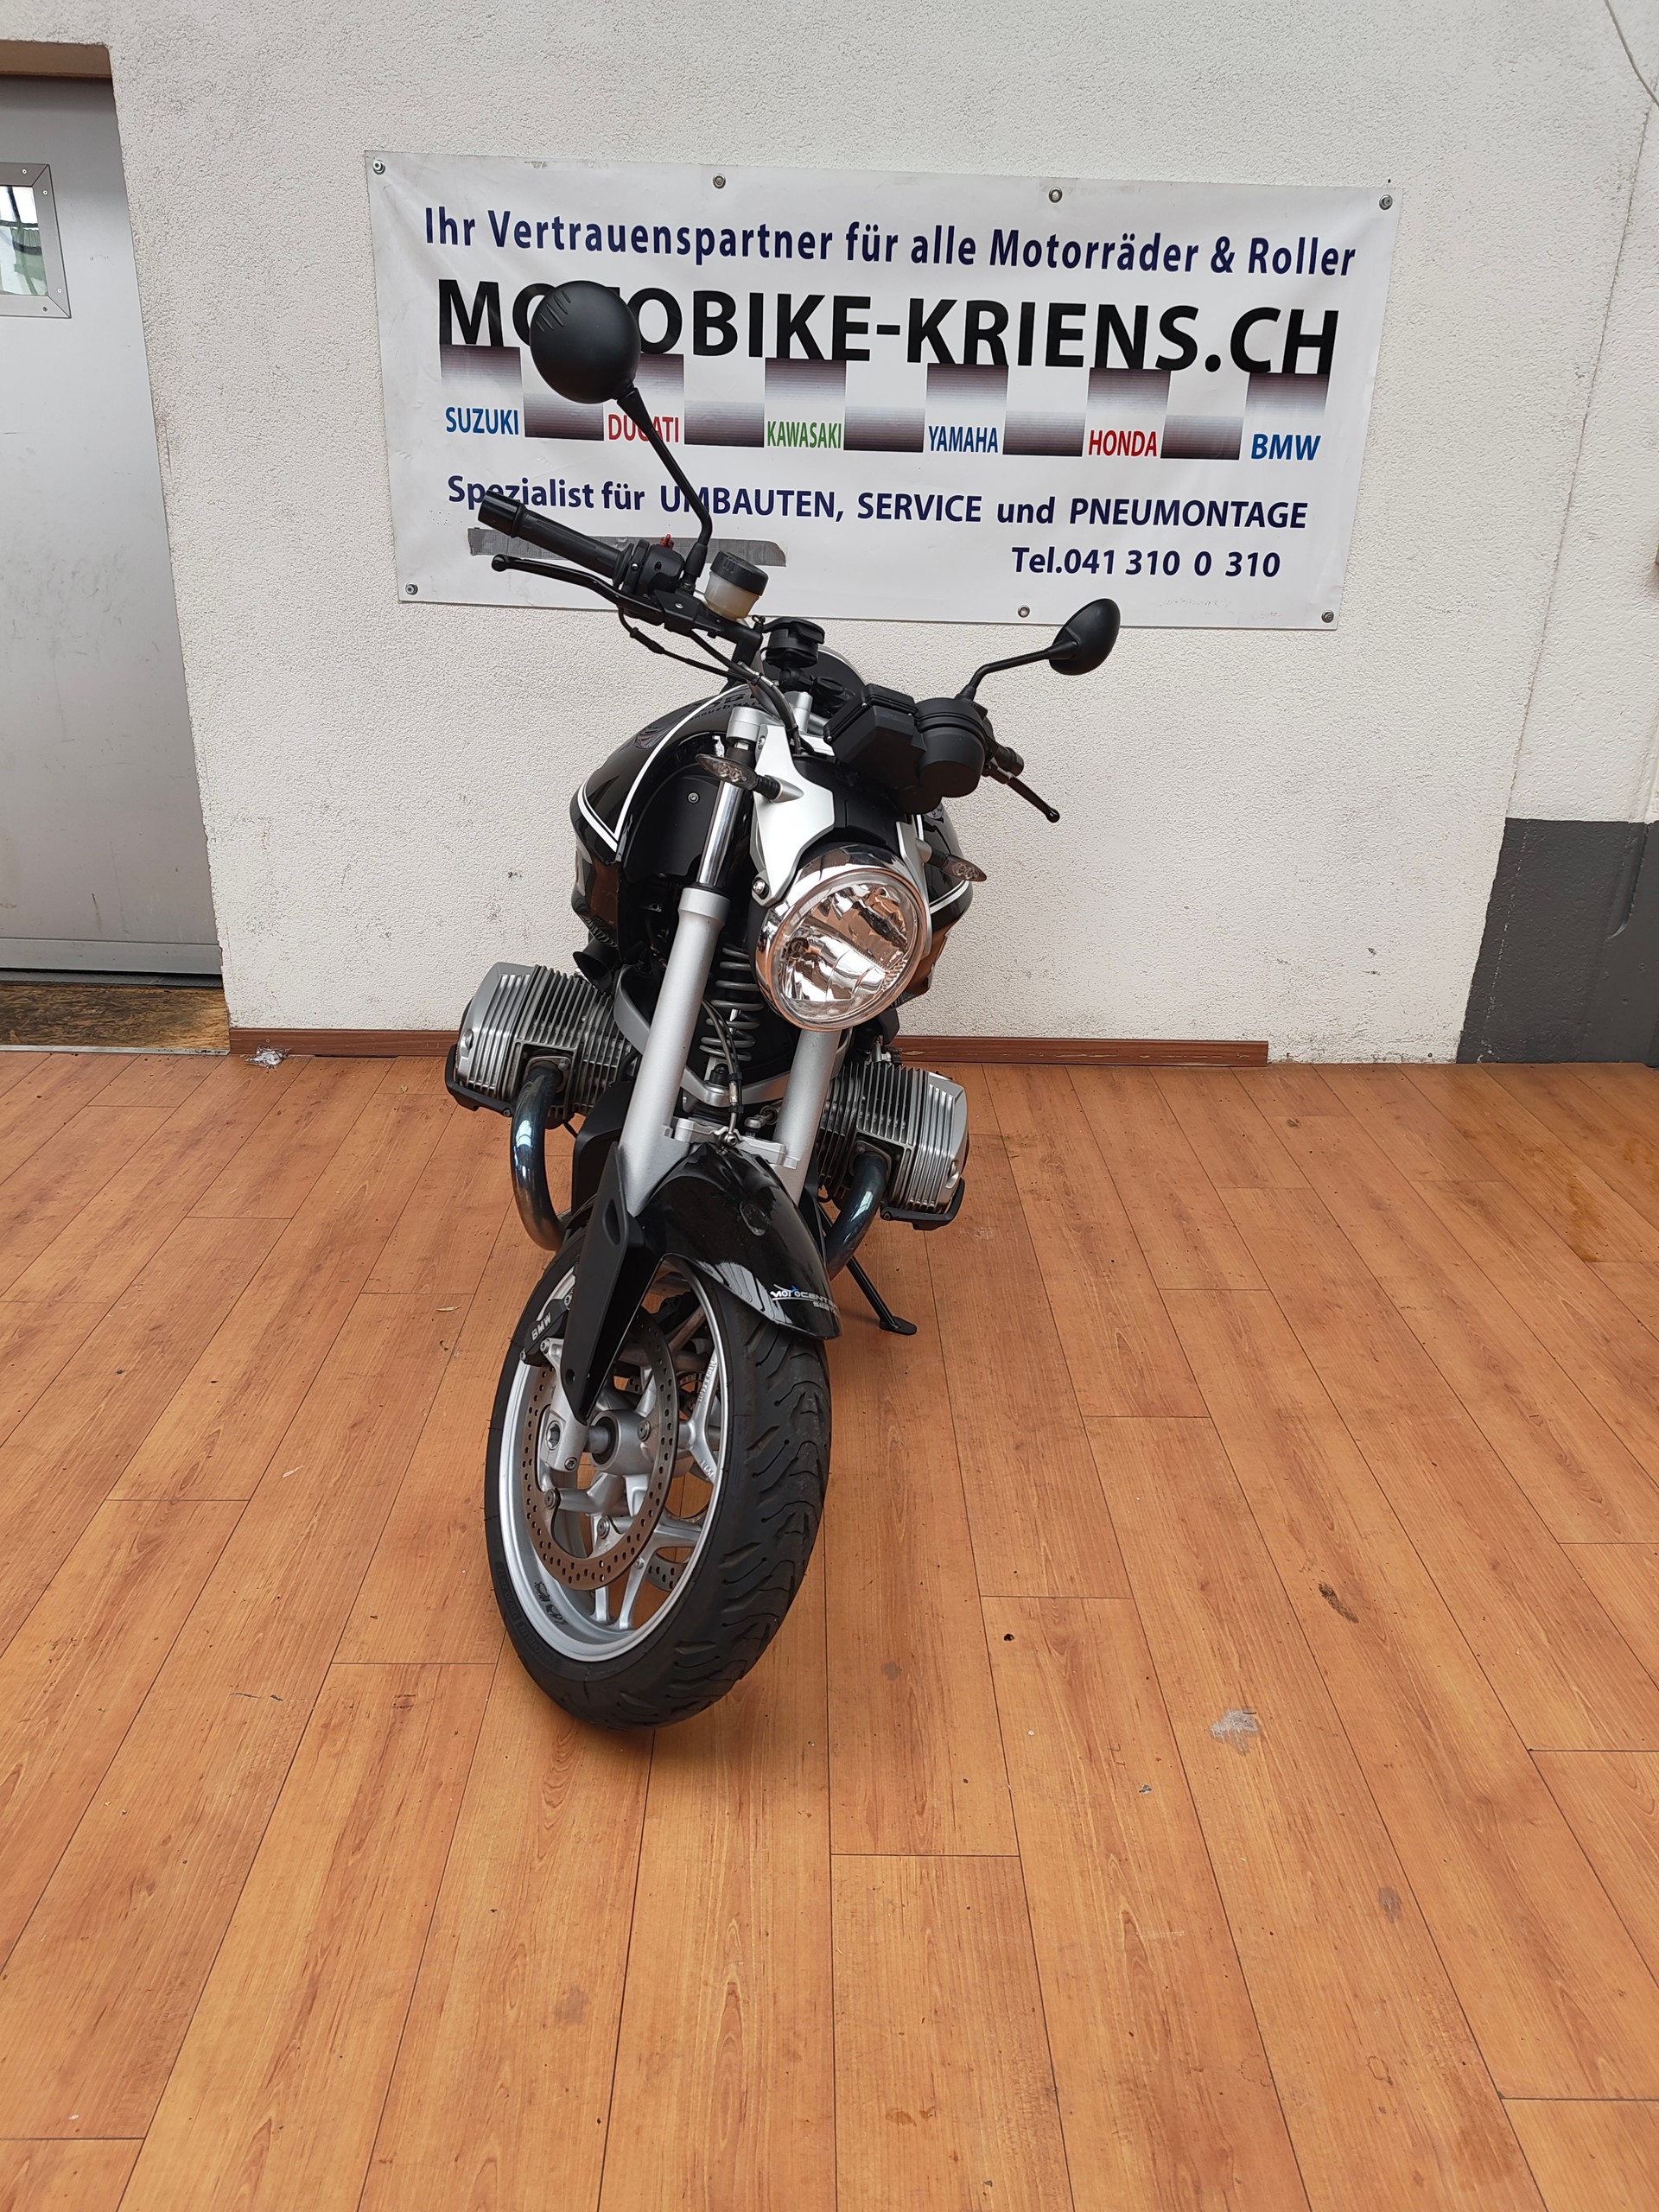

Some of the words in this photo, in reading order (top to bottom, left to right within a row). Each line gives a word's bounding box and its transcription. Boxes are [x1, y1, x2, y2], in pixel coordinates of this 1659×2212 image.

[426, 207, 475, 245] Ihr
[488, 210, 832, 265] Vertrauenspartner
[846, 222, 898, 262] für
[912, 226, 976, 265] alle
[990, 229, 1198, 271] Motorräder
[1211, 237, 1235, 273] &
[1249, 237, 1356, 276] Roller
[438, 279, 1338, 374] MOBIKE-KRIENS.CH
[446, 407, 518, 435] SUZUKI
[766, 421, 842, 448] KAWASAKI
[929, 426, 998, 452] YAMAHA
[1089, 430, 1157, 456] HONDA
[1251, 434, 1320, 460] BMW
[601, 481, 645, 510] für
[858, 493, 982, 522] SERVICE
[998, 497, 1055, 524] und
[1070, 499, 1307, 528] PNEUMONTAGE
[1012, 547, 1114, 574] Tel.041
[1126, 550, 1179, 575] 310
[1195, 551, 1211, 575] 0
[1225, 552, 1280, 577] 310
[531, 1312, 551, 1341] BMW
